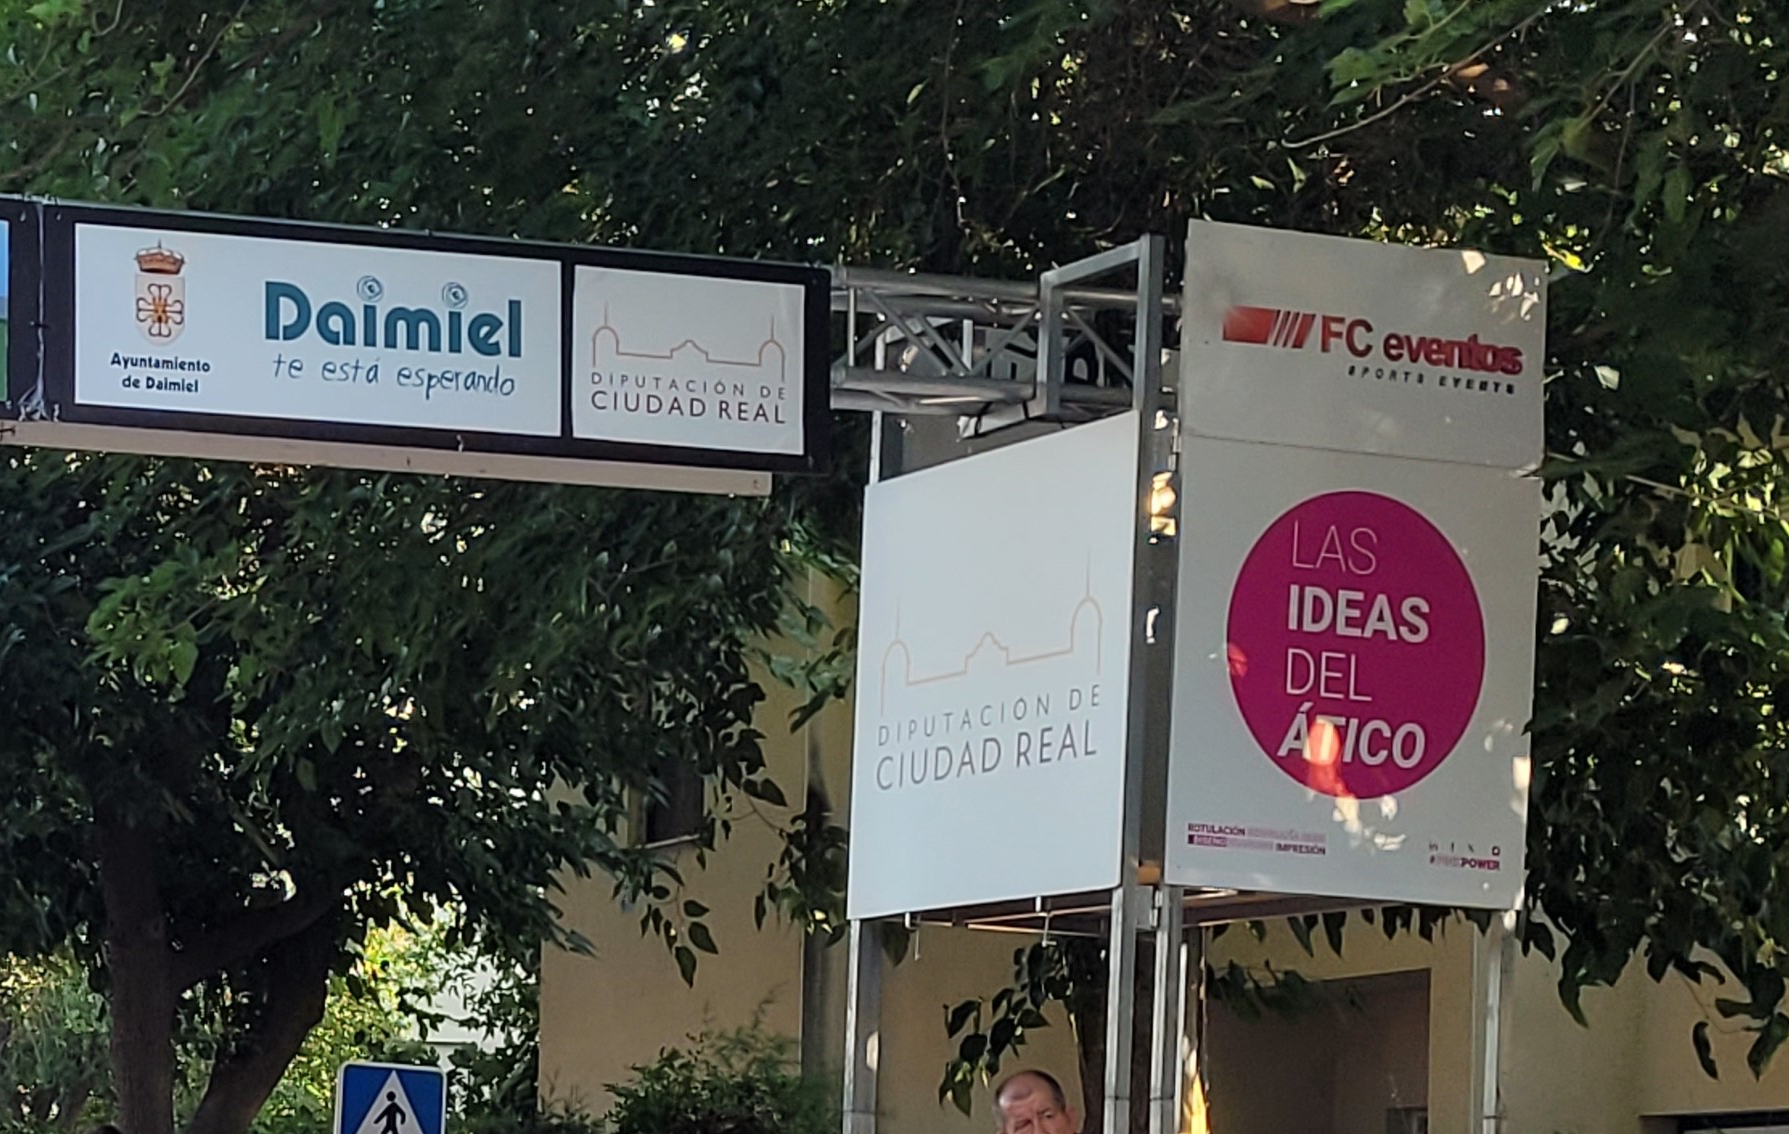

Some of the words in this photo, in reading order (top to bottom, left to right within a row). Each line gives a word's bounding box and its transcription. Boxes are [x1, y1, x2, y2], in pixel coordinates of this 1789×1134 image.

[264, 275, 521, 358] Daimiel
[110, 352, 211, 373] Ayuntamiento
[1320, 314, 1373, 358] FC
[1383, 332, 1523, 376] eventos
[122, 375, 141, 389] de
[146, 376, 199, 393] Daimiel
[272, 353, 304, 379] te
[321, 356, 380, 384] está
[397, 364, 516, 400] esperando
[760, 385, 787, 400] DE
[1348, 365, 1424, 384] SPORTS
[1439, 375, 1515, 394] EVENTS
[591, 390, 706, 417] CIUDAD
[718, 400, 786, 424] REAL
[1291, 520, 1378, 575] LAS
[1287, 584, 1430, 644] IDEAS
[1069, 684, 1101, 711] DE
[1286, 648, 1372, 702] DEL
[875, 738, 1002, 791] CIUDAD
[1015, 719, 1097, 769] REAL
[1277, 702, 1426, 769] ÁTICO
